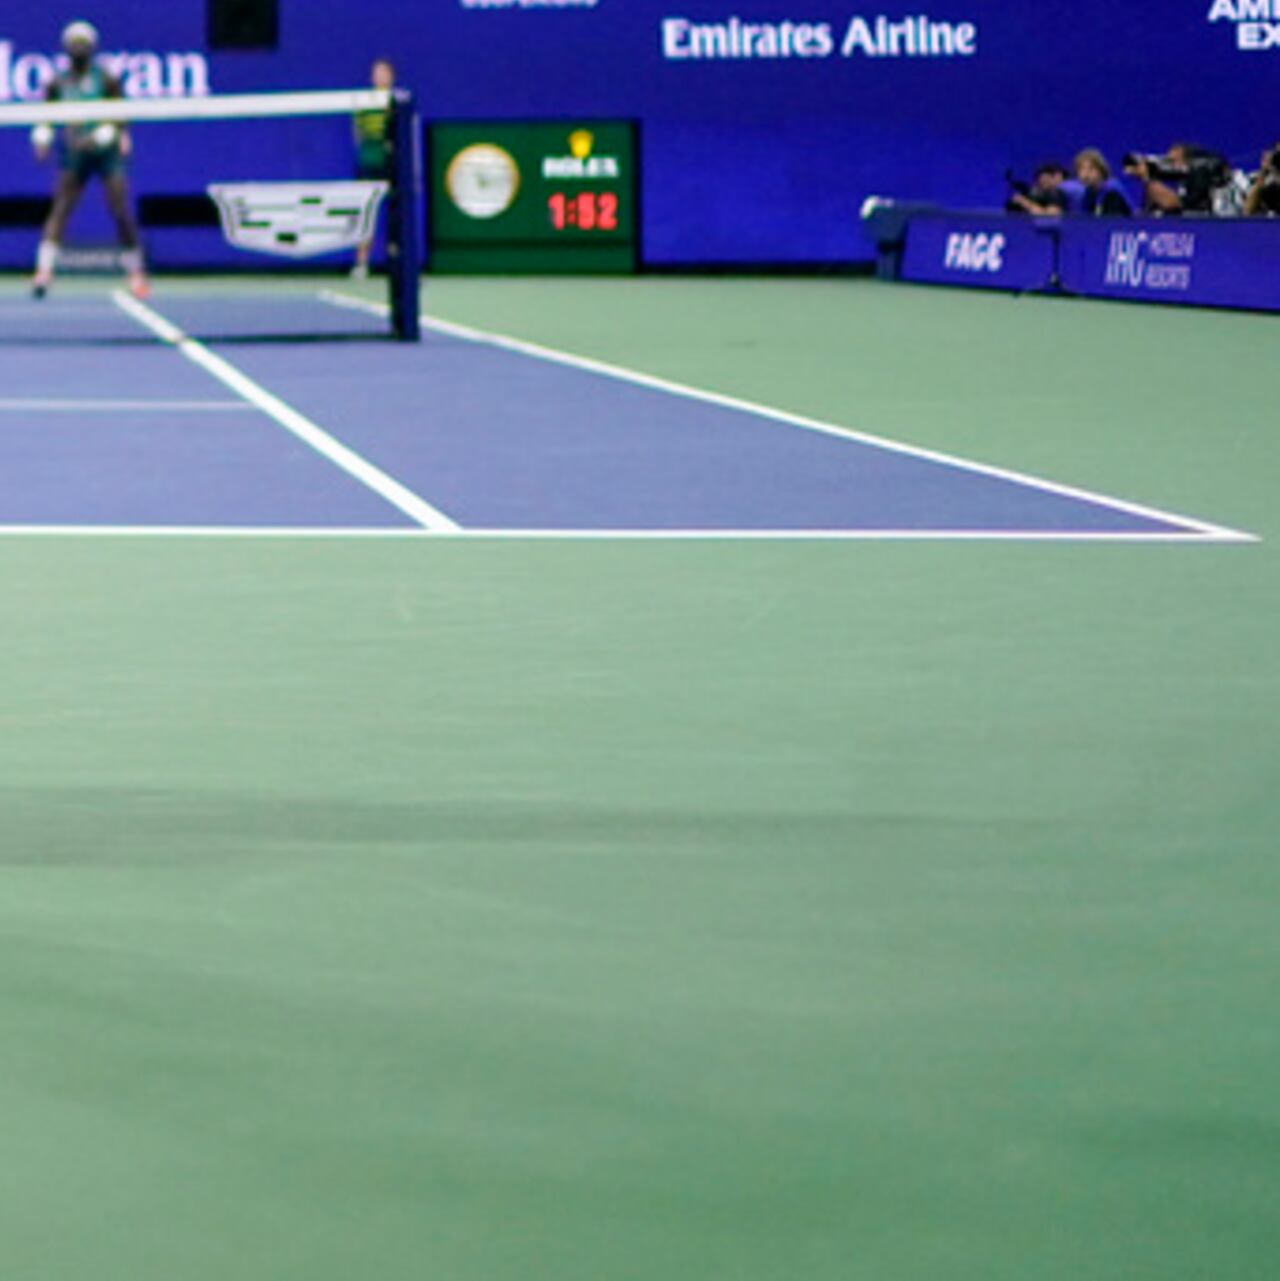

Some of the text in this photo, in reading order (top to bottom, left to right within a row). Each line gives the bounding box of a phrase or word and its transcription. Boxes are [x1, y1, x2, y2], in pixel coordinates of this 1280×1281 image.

[663, 15, 976, 58] Emirates Airline
[1105, 231, 1146, 287] IHG
